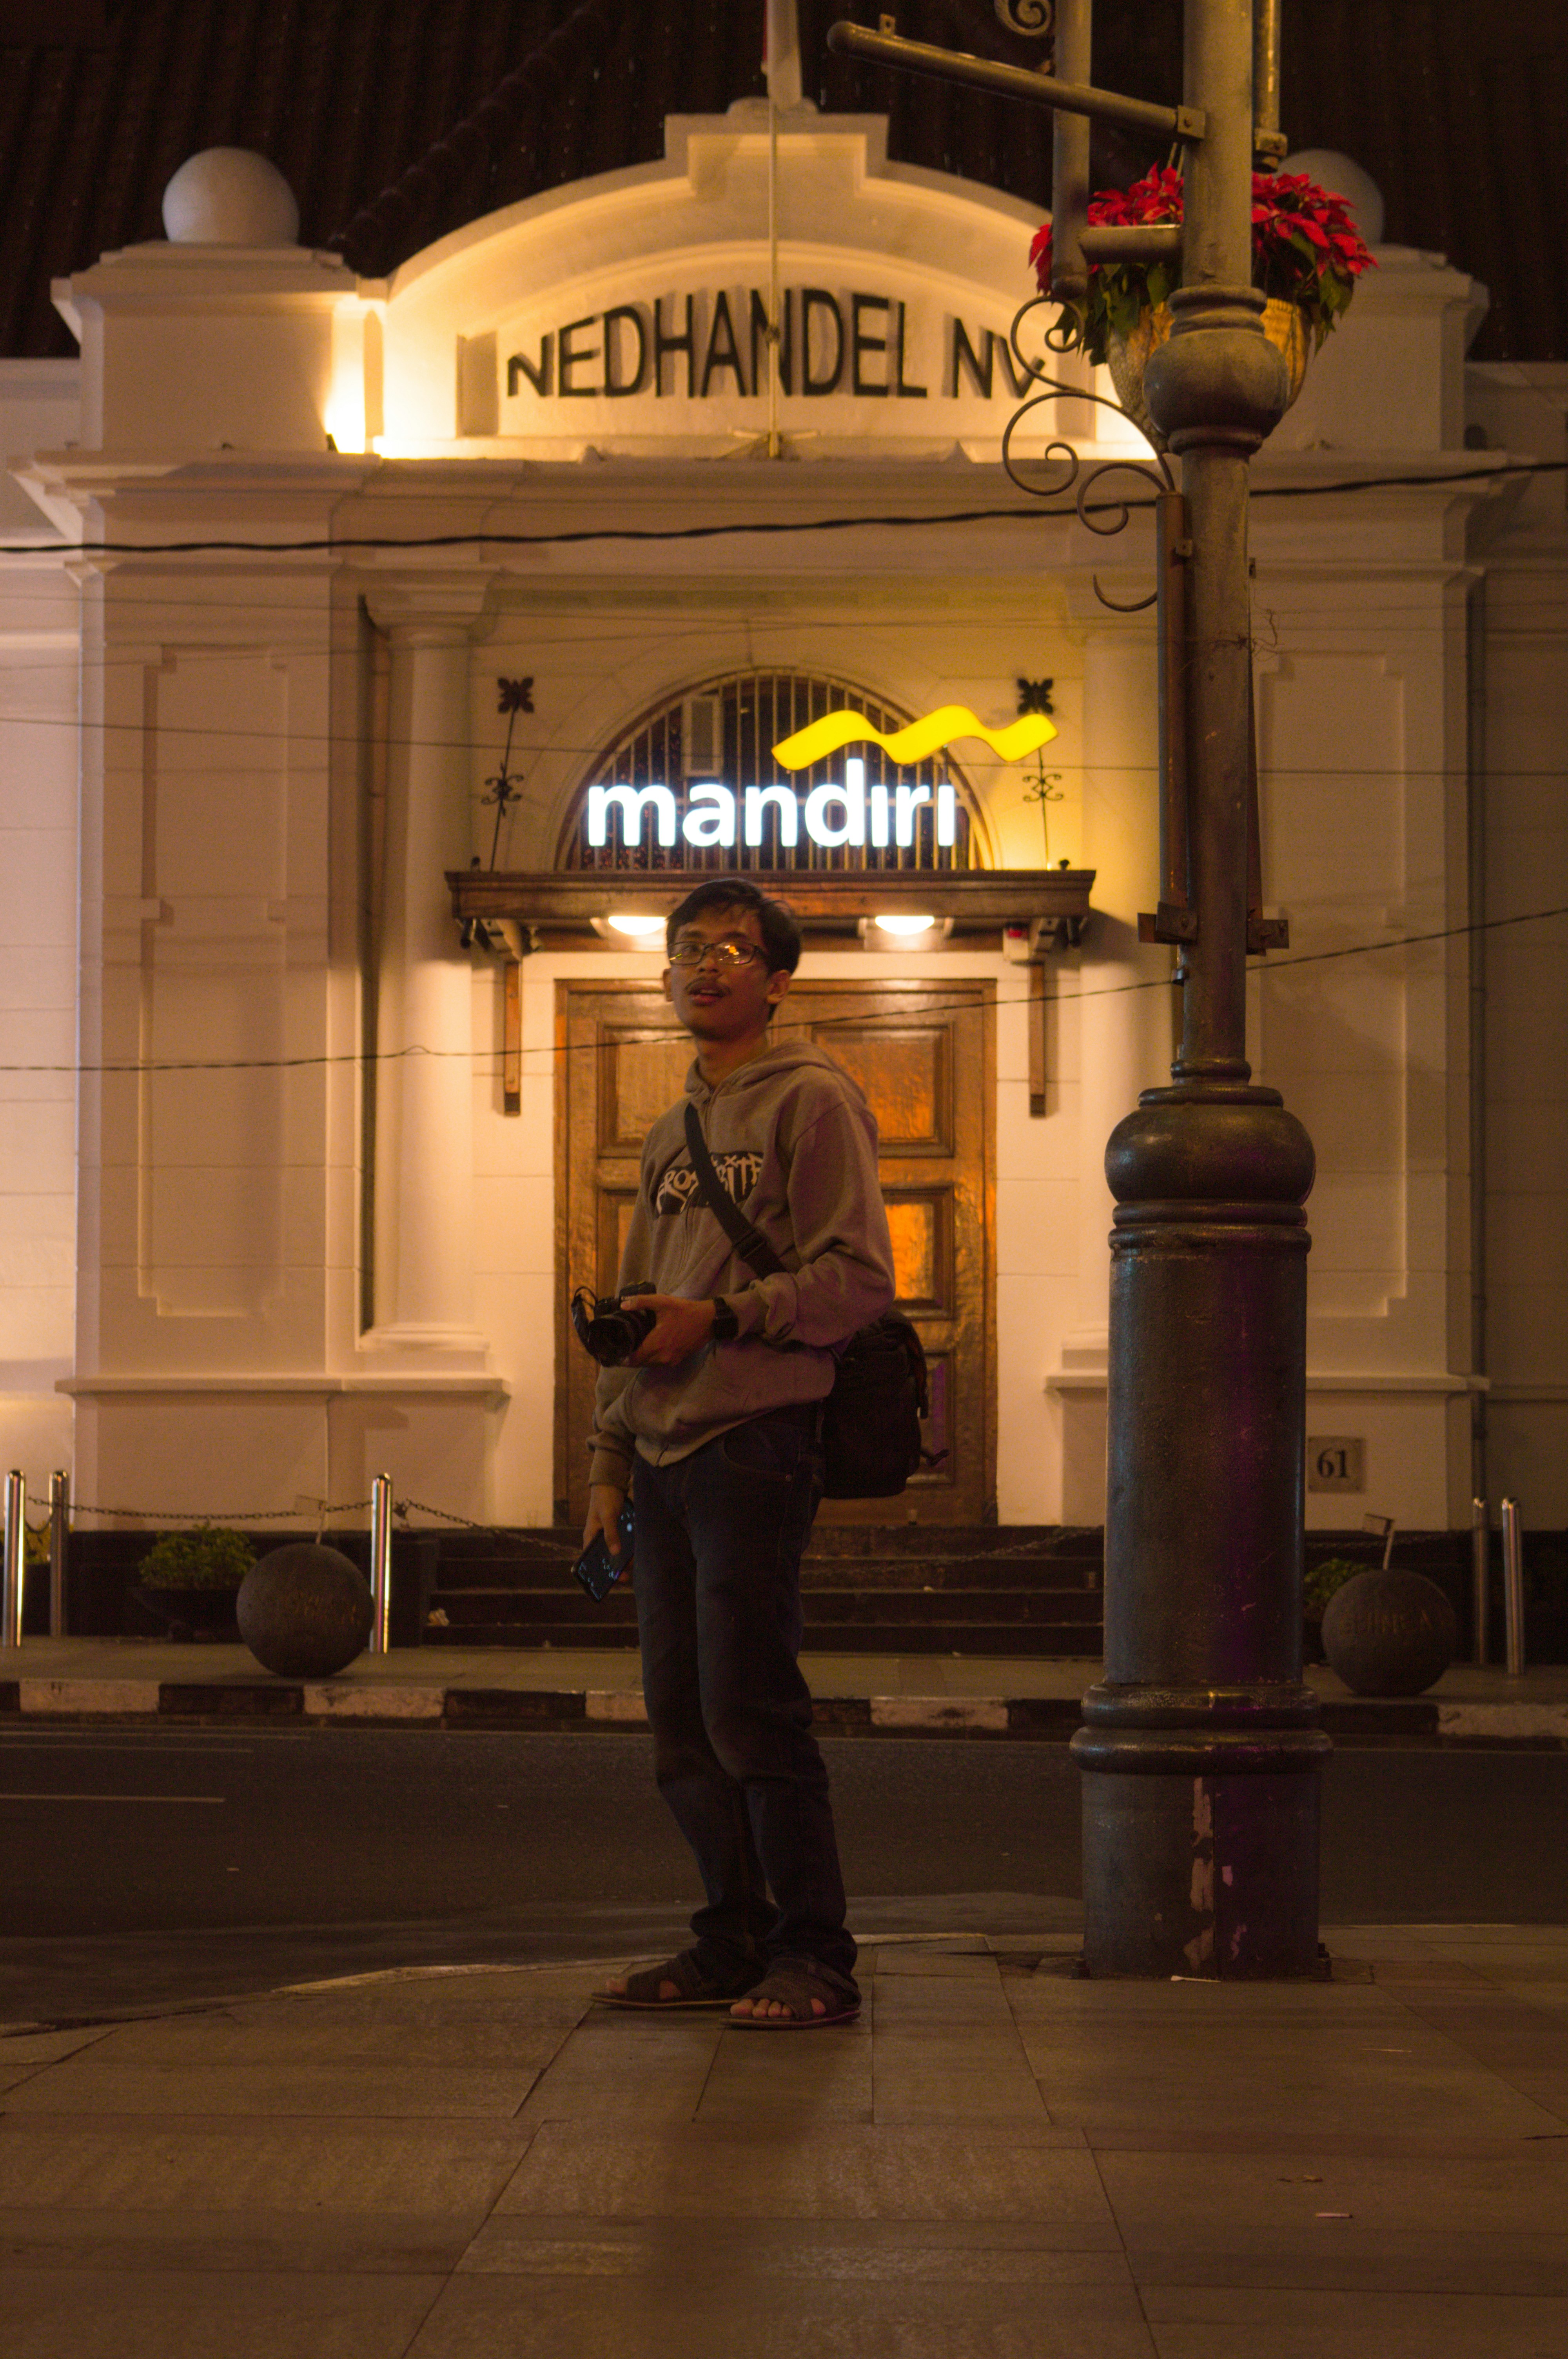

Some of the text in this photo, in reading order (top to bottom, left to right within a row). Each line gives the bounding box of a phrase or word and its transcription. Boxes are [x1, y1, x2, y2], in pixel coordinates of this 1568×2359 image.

[507, 287, 927, 398] NEDHANDEL
[587, 758, 956, 848] mandiri
[1317, 1448, 1348, 1478] 61
